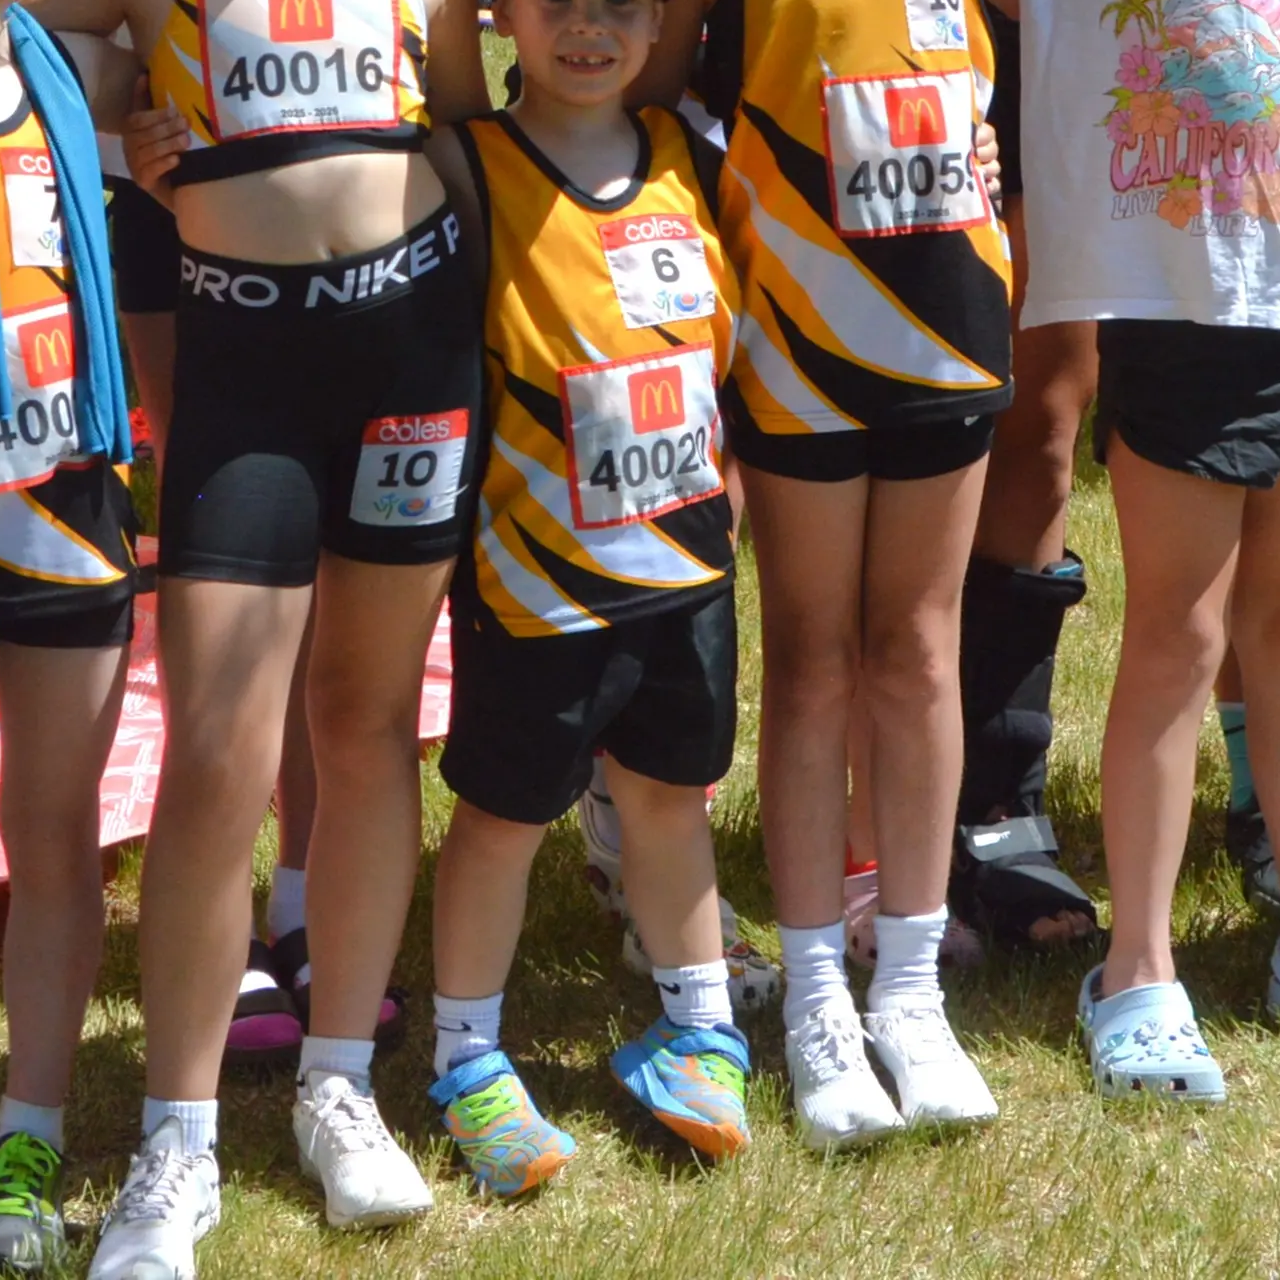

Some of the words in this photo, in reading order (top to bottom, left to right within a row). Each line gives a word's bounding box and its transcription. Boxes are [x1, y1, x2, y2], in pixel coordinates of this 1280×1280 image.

[223, 47, 384, 102] 40016
[280, 108, 306, 119] 2025
[314, 106, 339, 118] 2026
[624, 216, 687, 242] coles
[180, 254, 280, 308] PRO
[305, 230, 440, 308] NIKE
[651, 248, 680, 283] 6
[379, 418, 451, 442] coles
[377, 450, 438, 488] 10
